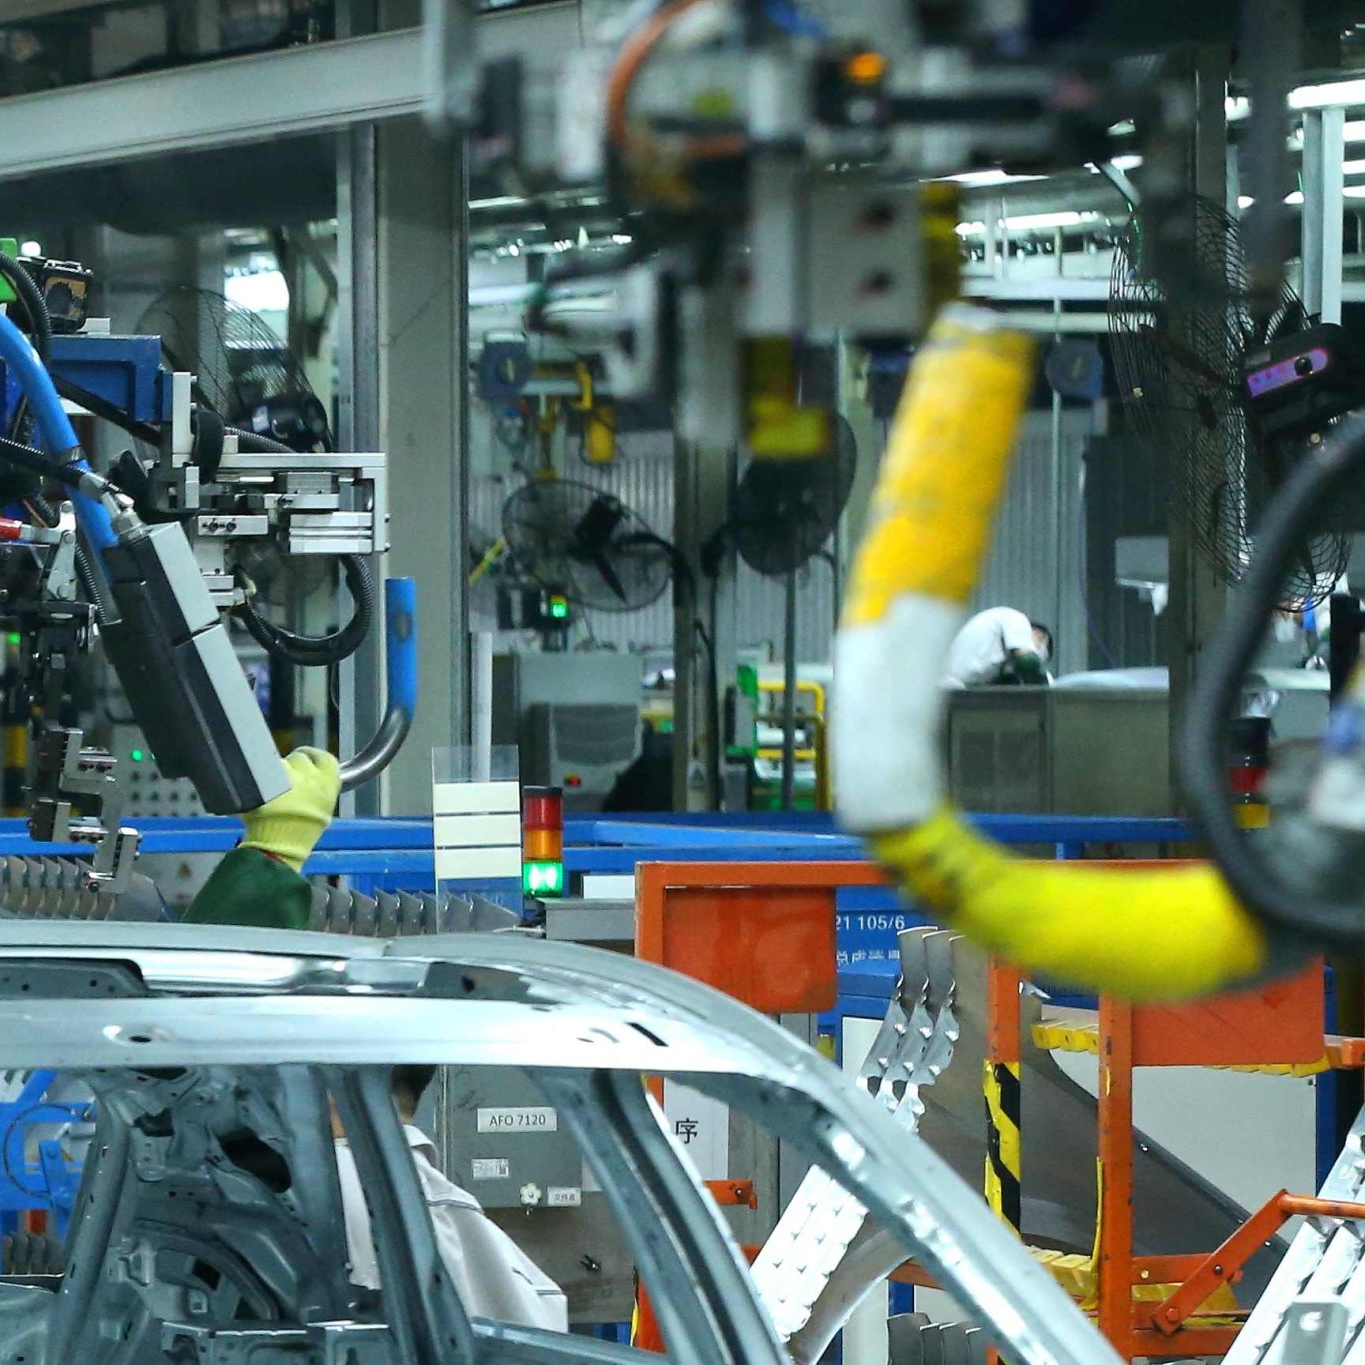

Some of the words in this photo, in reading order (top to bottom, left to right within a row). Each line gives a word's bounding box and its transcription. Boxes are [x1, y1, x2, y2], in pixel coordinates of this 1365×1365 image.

[858, 914, 905, 930] 105/6
[489, 1114, 514, 1127] AFO
[517, 1114, 546, 1126] 7120
[676, 1117, 699, 1145] 序
